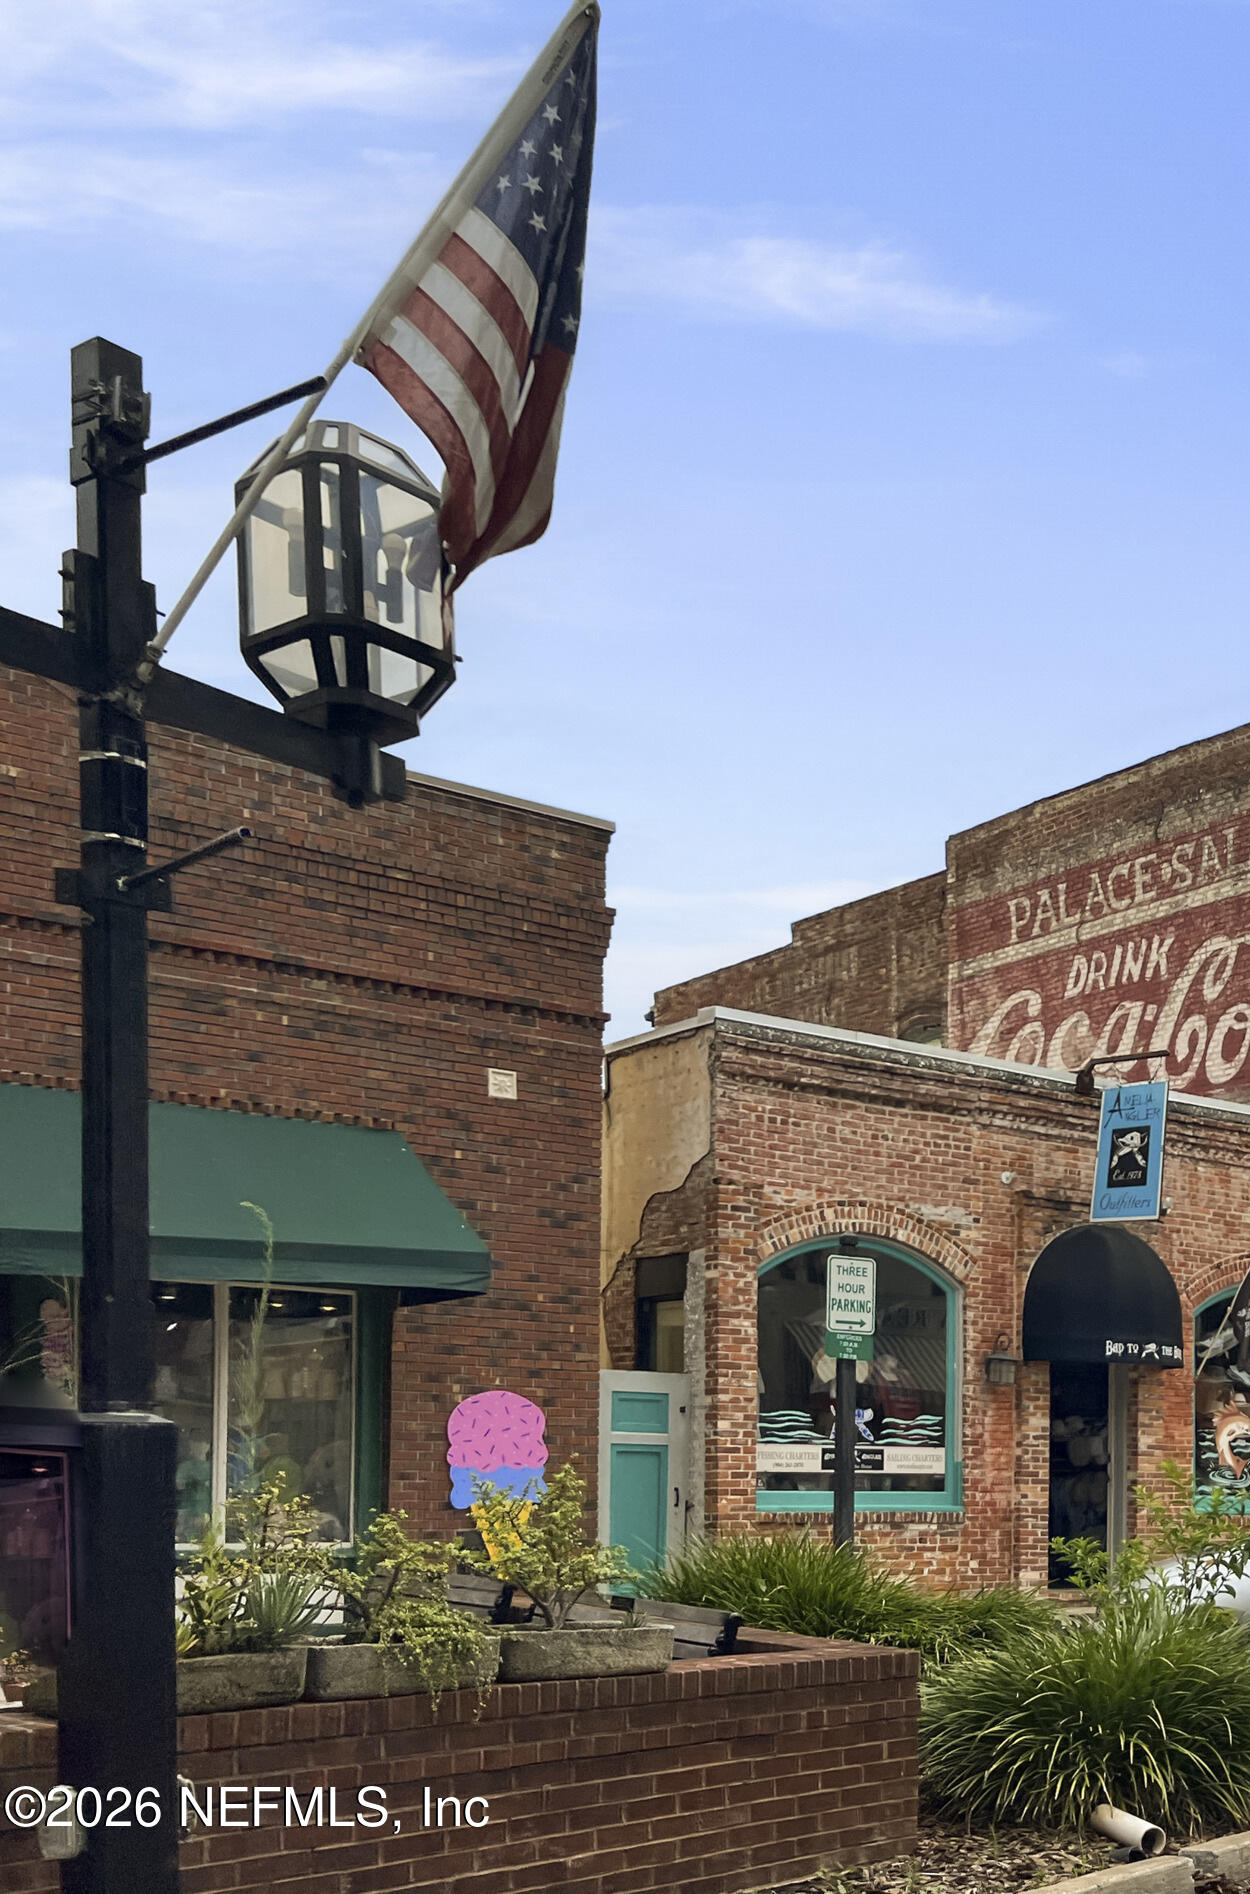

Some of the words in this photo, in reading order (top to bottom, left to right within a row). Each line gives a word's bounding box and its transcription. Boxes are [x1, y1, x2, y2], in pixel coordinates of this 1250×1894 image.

[1007, 852, 1158, 944] PALACE
[1064, 934, 1176, 999] DRINK
[1100, 1192, 1151, 1215] Outfitters
[836, 1265, 868, 1277] THREE
[837, 1283, 865, 1294] HOUR
[831, 1298, 871, 1313] PARKING
